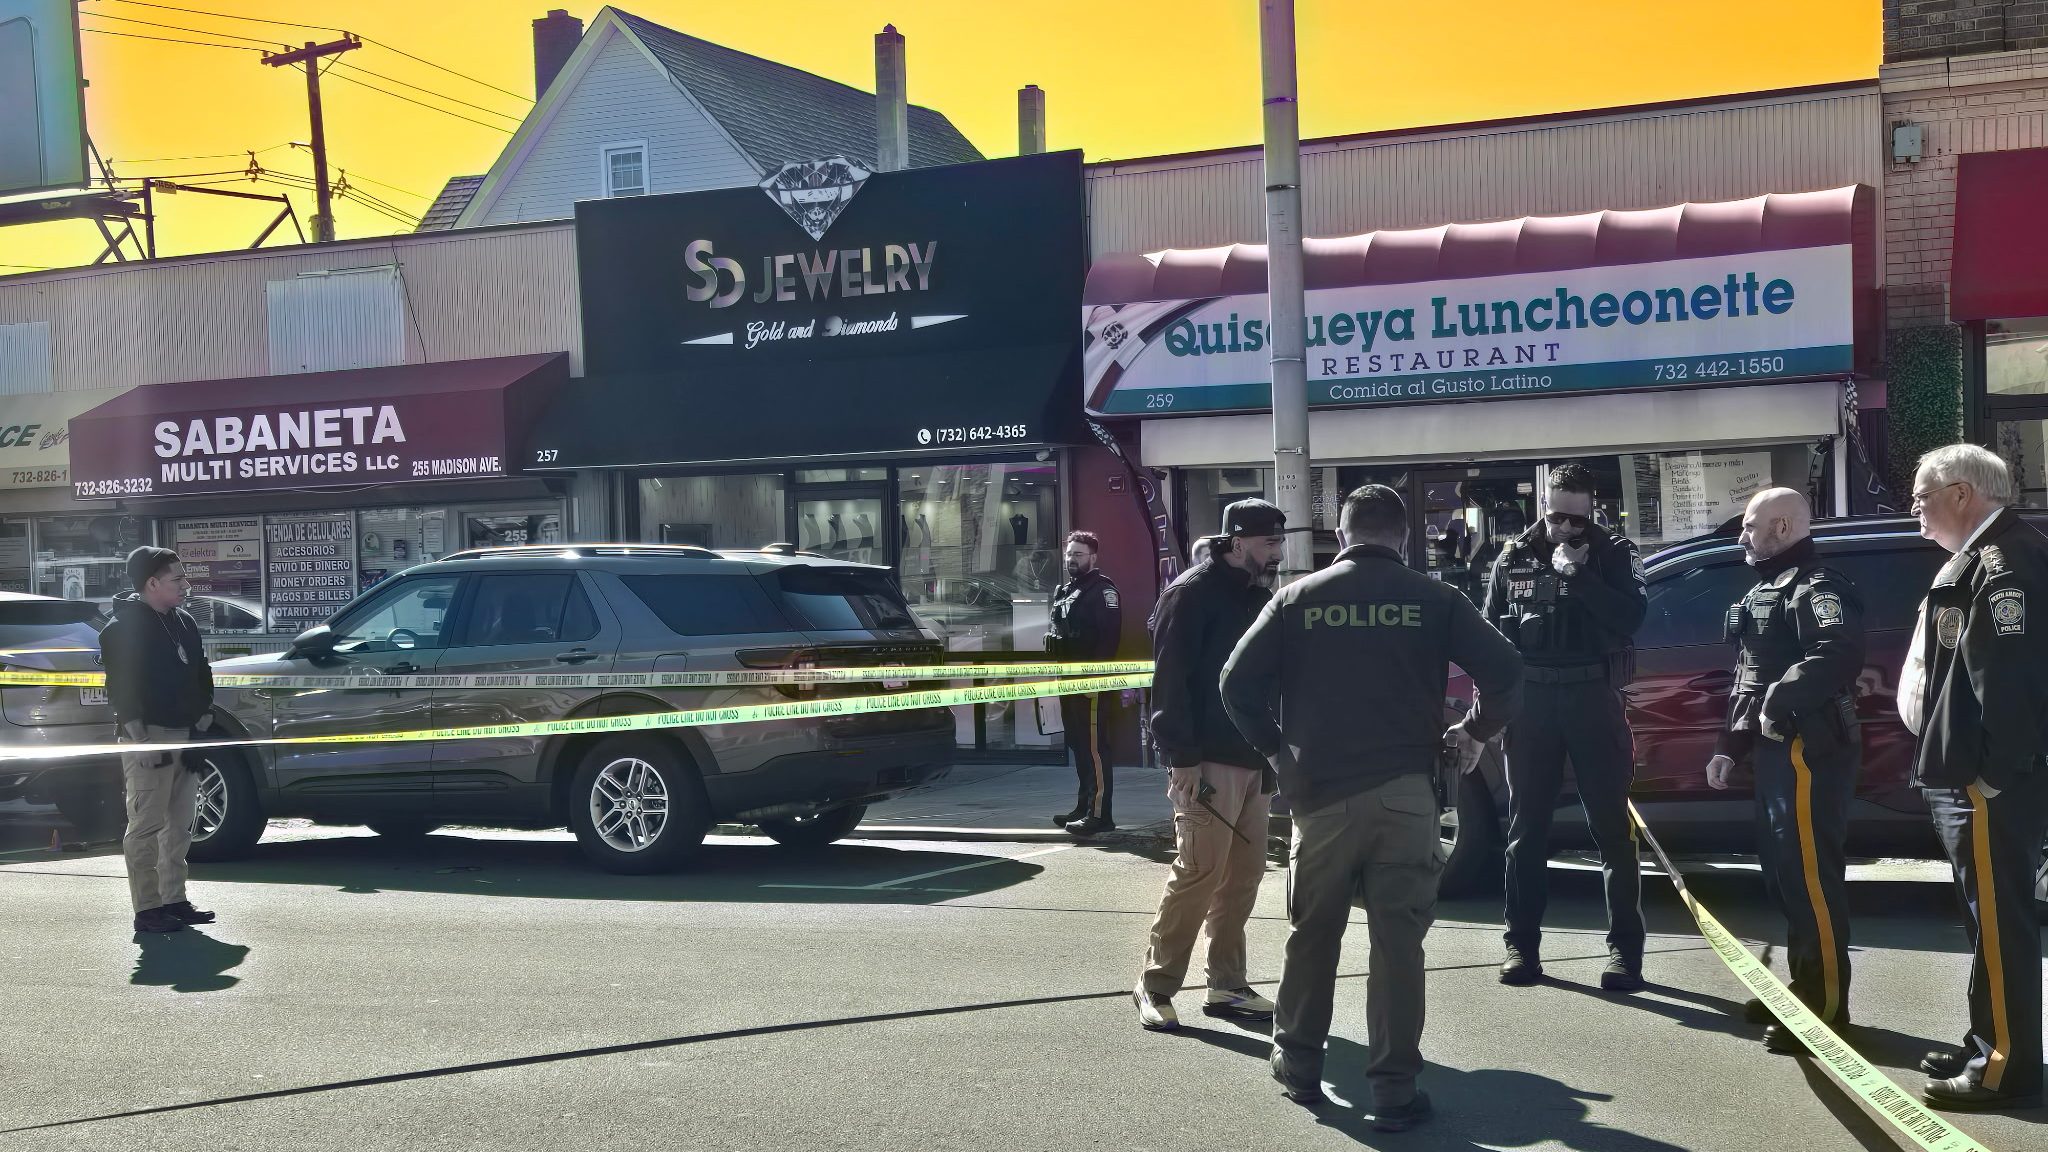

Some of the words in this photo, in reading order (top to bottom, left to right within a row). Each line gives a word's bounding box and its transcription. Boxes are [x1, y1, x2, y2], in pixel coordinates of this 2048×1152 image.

[754, 240, 937, 304] JEWELRY
[1165, 307, 1415, 357] Quisueya
[1431, 272, 1795, 339] Luncheonette
[745, 320, 785, 350] Gold
[788, 319, 816, 339] and
[1322, 343, 1560, 375] RESTAURANT
[1655, 363, 1688, 380] 732
[1694, 357, 1785, 379] 442-1550
[1329, 384, 1402, 399] Comida
[1407, 380, 1426, 395] al
[1431, 378, 1486, 394] Gusto
[1491, 374, 1552, 390] Latino
[1146, 392, 1174, 408] 259
[154, 405, 406, 458] SABANETA
[935, 427, 966, 443] (732)
[969, 424, 1027, 441] 642-4365
[537, 450, 558, 462] 257
[161, 460, 232, 483] MULTI
[239, 451, 358, 479] SERVICES
[366, 455, 400, 471] LLC
[412, 461, 430, 476] 255
[431, 459, 475, 475] MADISON
[478, 457, 502, 473] AVE.
[75, 478, 153, 496] 732-826-3232
[266, 524, 293, 543] TIENDA
[295, 523, 306, 541] DE
[308, 521, 351, 541] CELULARES
[504, 530, 527, 542] 255
[276, 545, 335, 557] ACCESORIOS
[269, 562, 297, 573] ENVIO
[300, 561, 312, 572] DE
[315, 560, 350, 571] DINERO
[273, 577, 306, 588] MONEY
[308, 576, 346, 587] ORDERS
[271, 592, 301, 602] PAGOS
[303, 591, 315, 601] DE
[318, 590, 351, 601] BILLES
[268, 607, 309, 617] NOTARIO
[1304, 604, 1421, 630] POLICE
